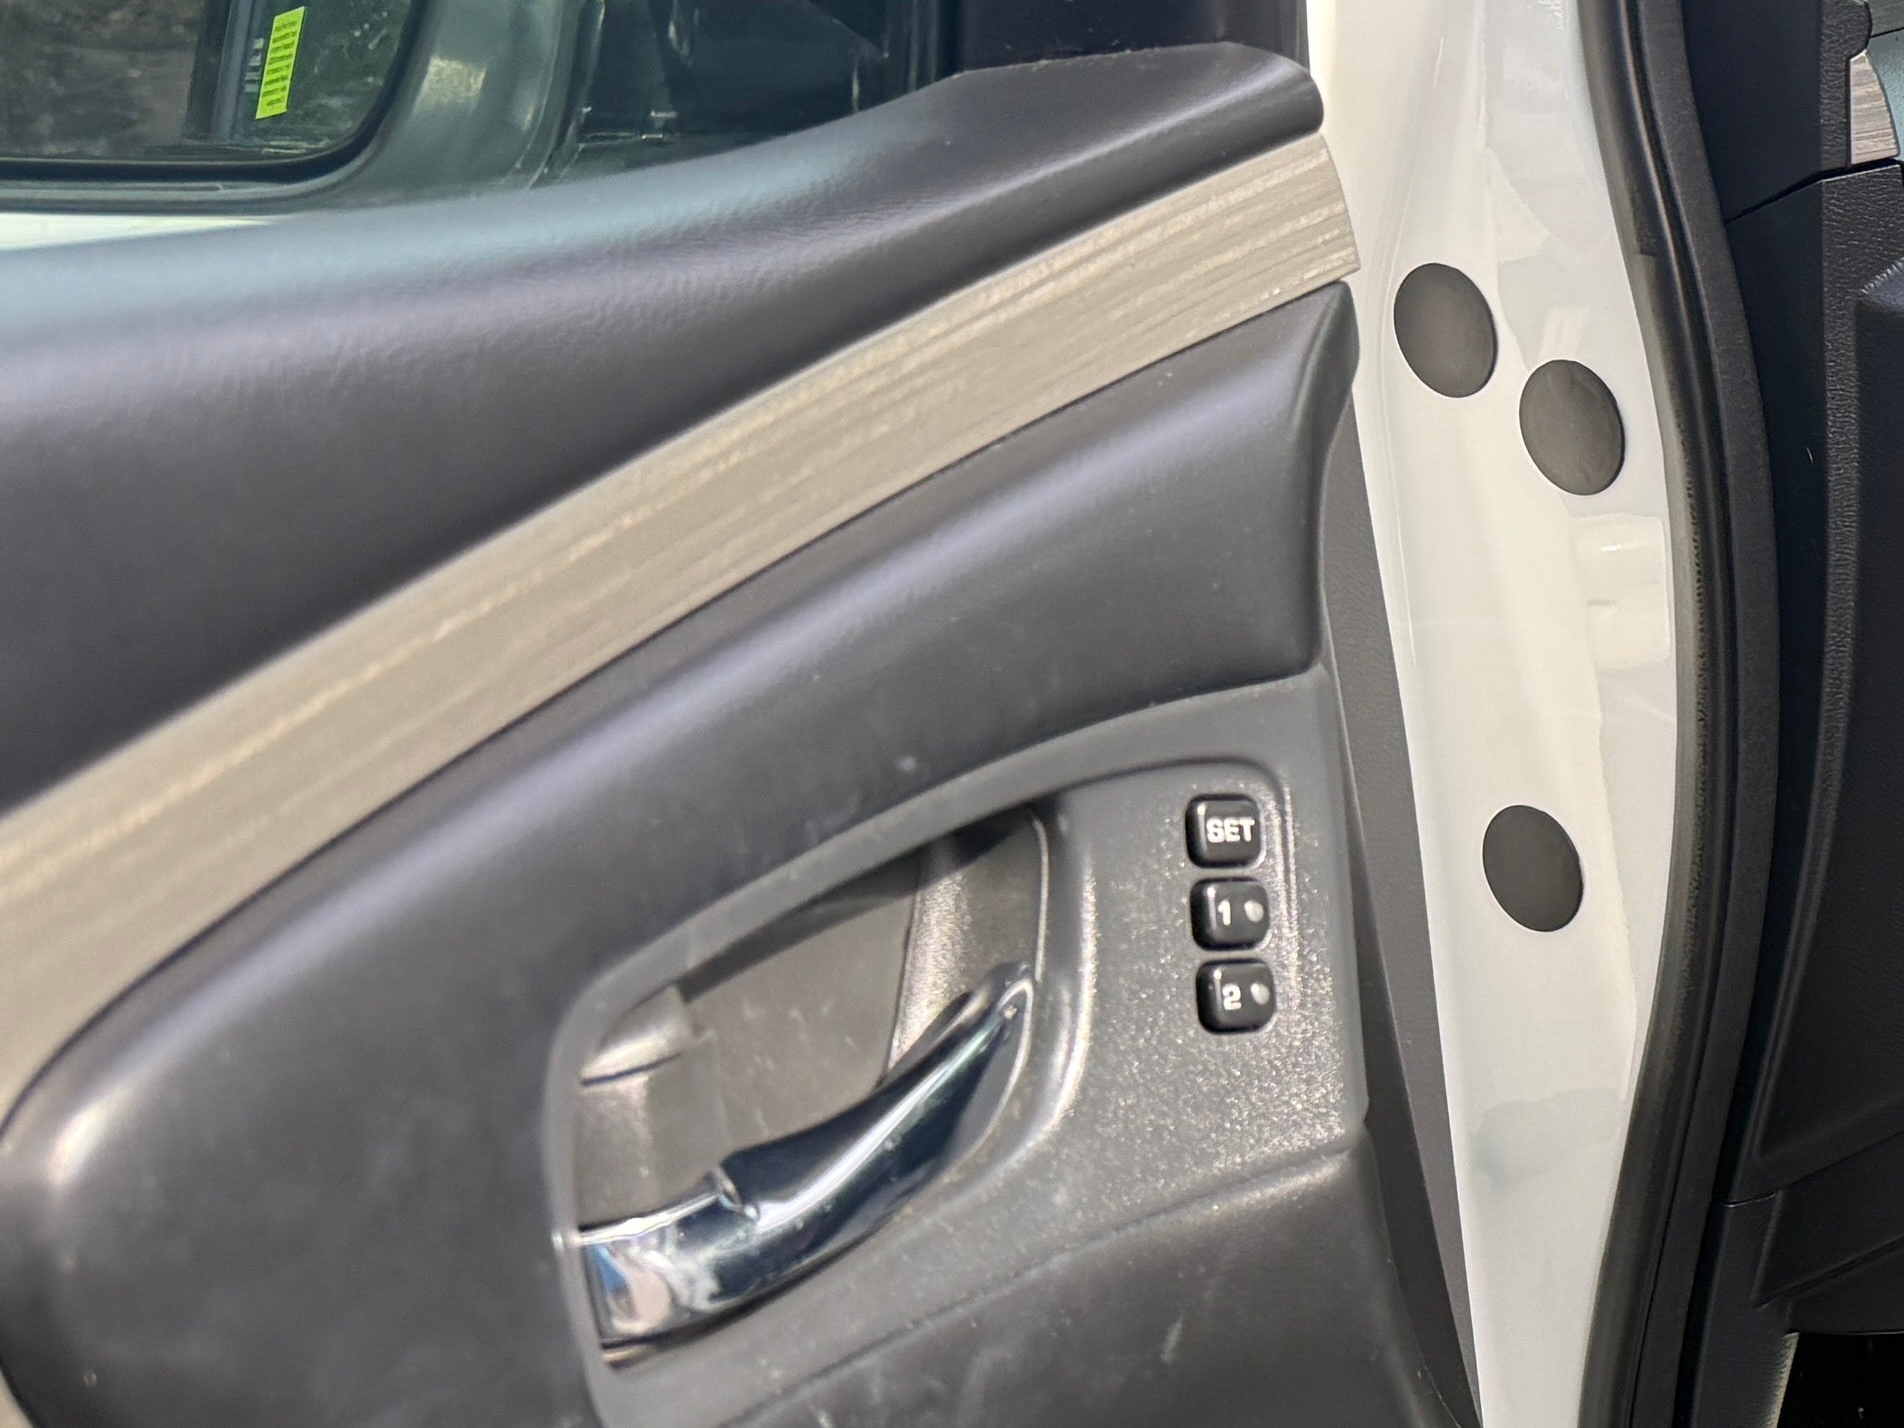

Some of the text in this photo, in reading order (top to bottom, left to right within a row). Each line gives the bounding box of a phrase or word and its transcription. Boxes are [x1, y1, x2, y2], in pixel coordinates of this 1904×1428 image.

[1206, 817, 1256, 844] SET
[1217, 899, 1232, 927] 1
[1222, 983, 1243, 1011] 2
